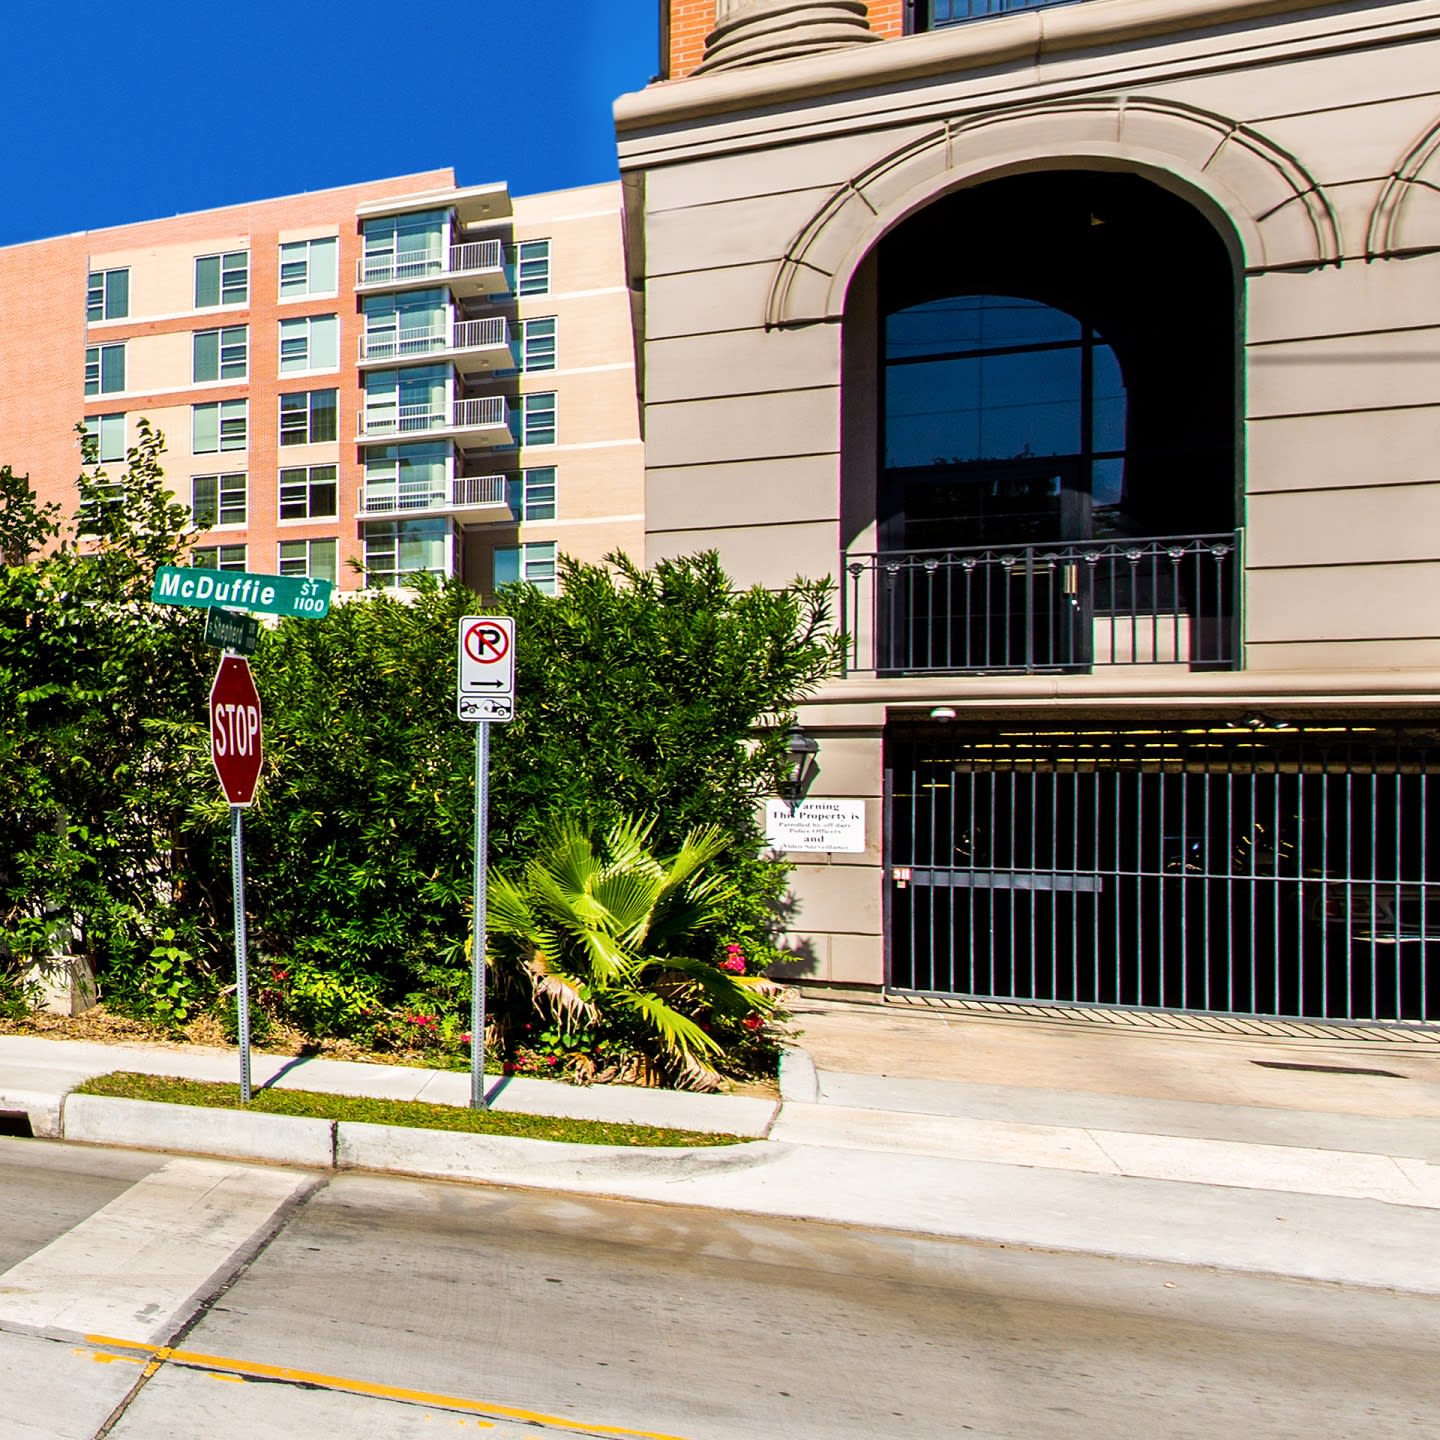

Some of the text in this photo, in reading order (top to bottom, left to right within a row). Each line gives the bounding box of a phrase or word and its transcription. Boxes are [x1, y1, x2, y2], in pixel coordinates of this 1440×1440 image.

[159, 573, 319, 605] McDuffie ST
[294, 597, 324, 613] 1100
[215, 703, 258, 757] STOP
[799, 812, 846, 821] Property
[851, 812, 860, 820] is
